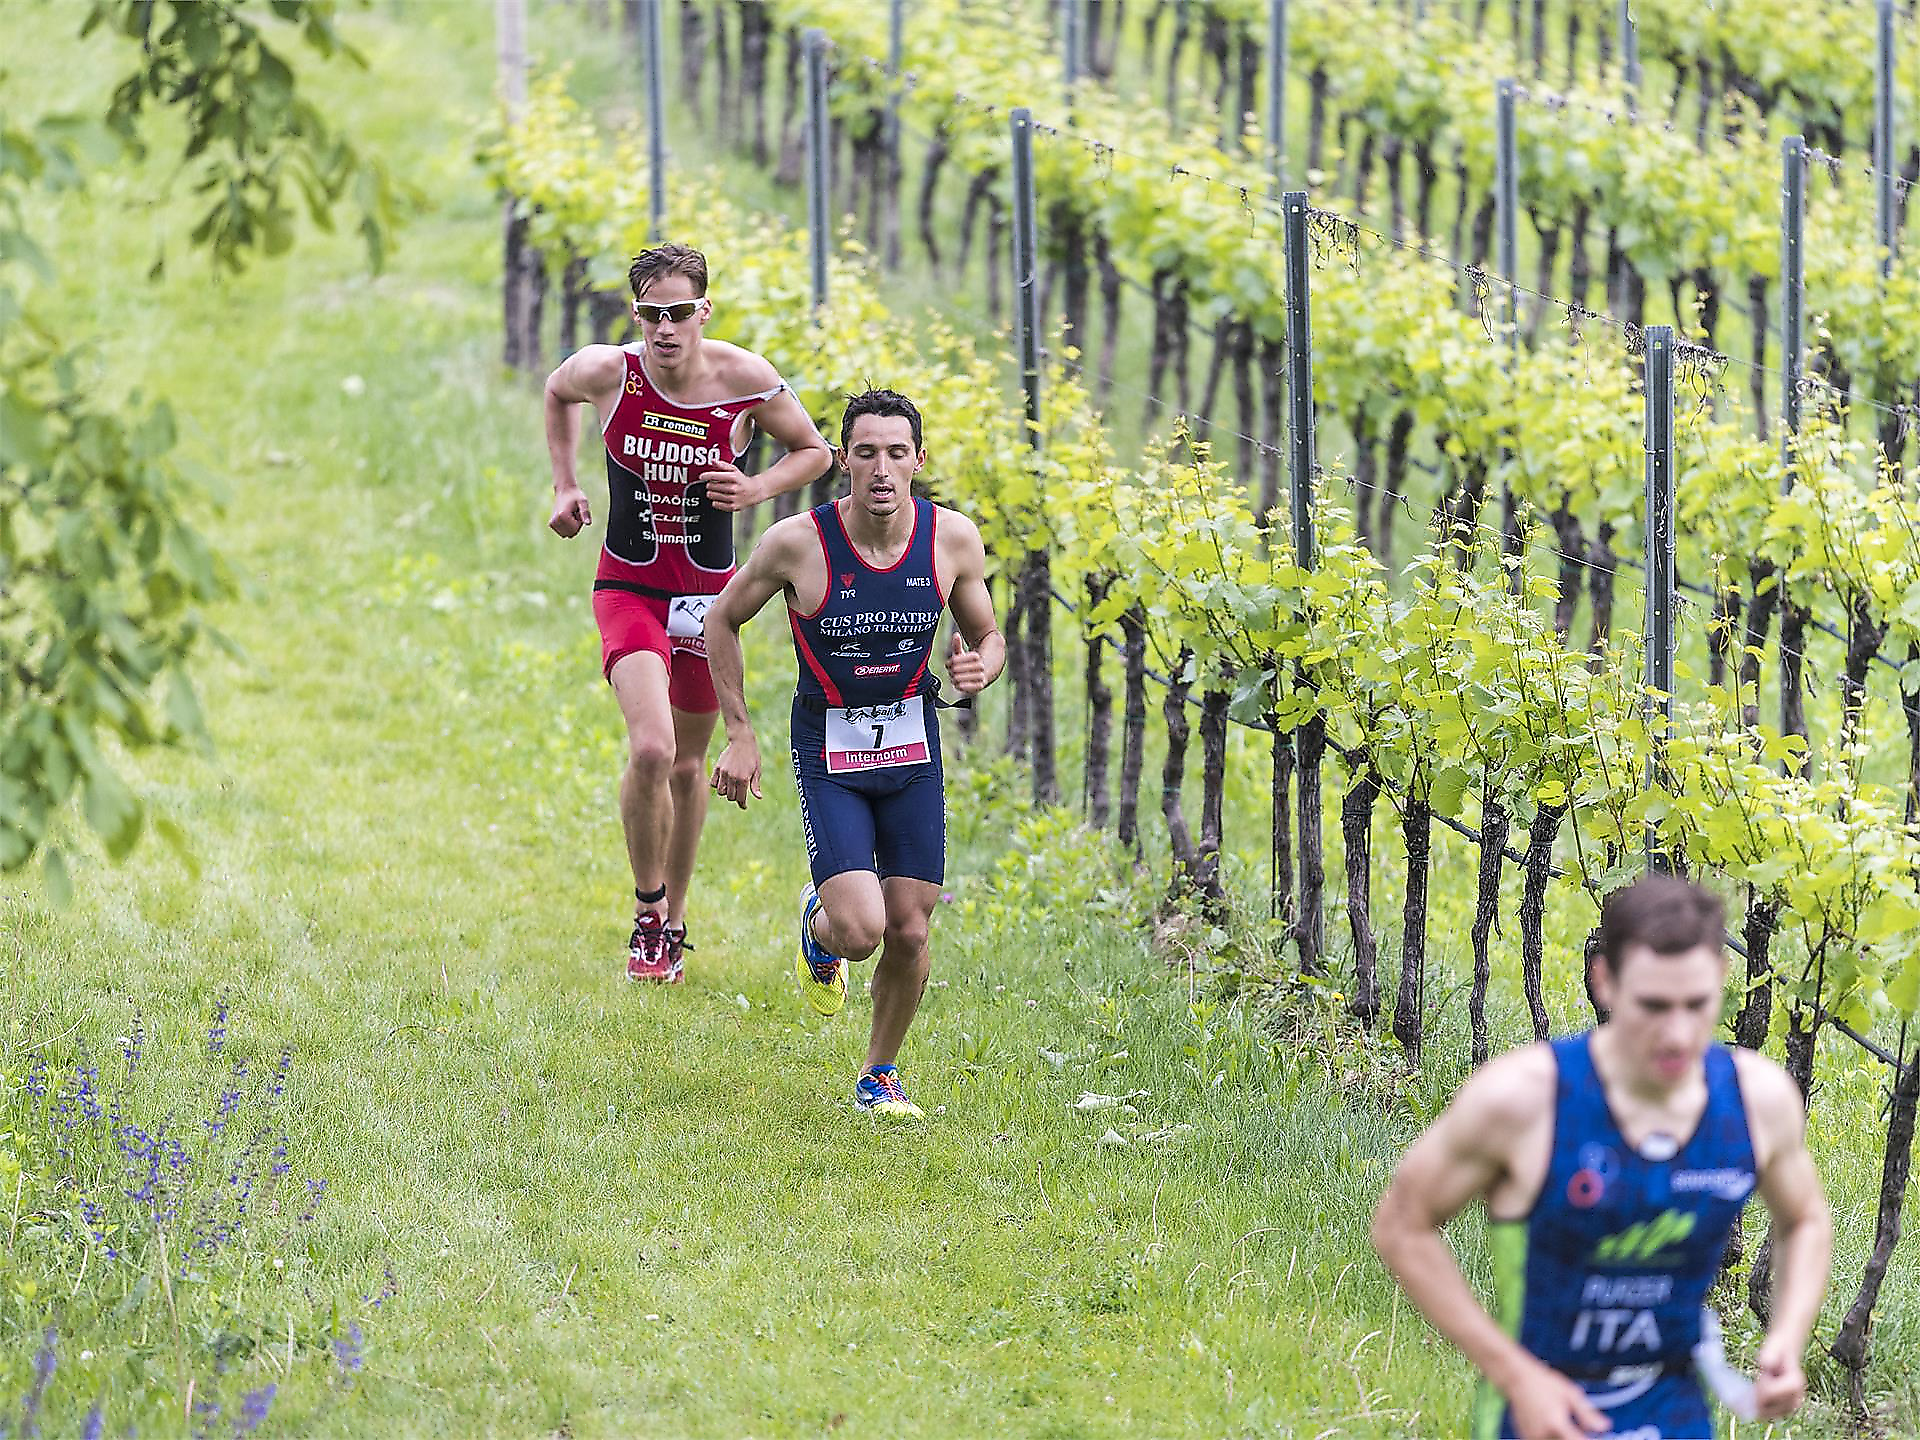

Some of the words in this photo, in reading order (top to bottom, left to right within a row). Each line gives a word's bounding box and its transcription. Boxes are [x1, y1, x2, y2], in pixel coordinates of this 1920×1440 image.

[663, 420, 705, 436] remeha
[643, 462, 689, 484] HUN
[906, 577, 925, 587] MATE
[925, 577, 931, 587] 3
[840, 589, 856, 600] TYR
[820, 615, 852, 628] CUS
[854, 611, 887, 626] PRO
[890, 610, 939, 624] PATRIA
[820, 624, 871, 637] MILANO
[868, 664, 901, 674] ENERVIT
[871, 724, 884, 749] 7
[845, 746, 908, 763] Internorm
[1571, 1309, 1661, 1350] ITA
